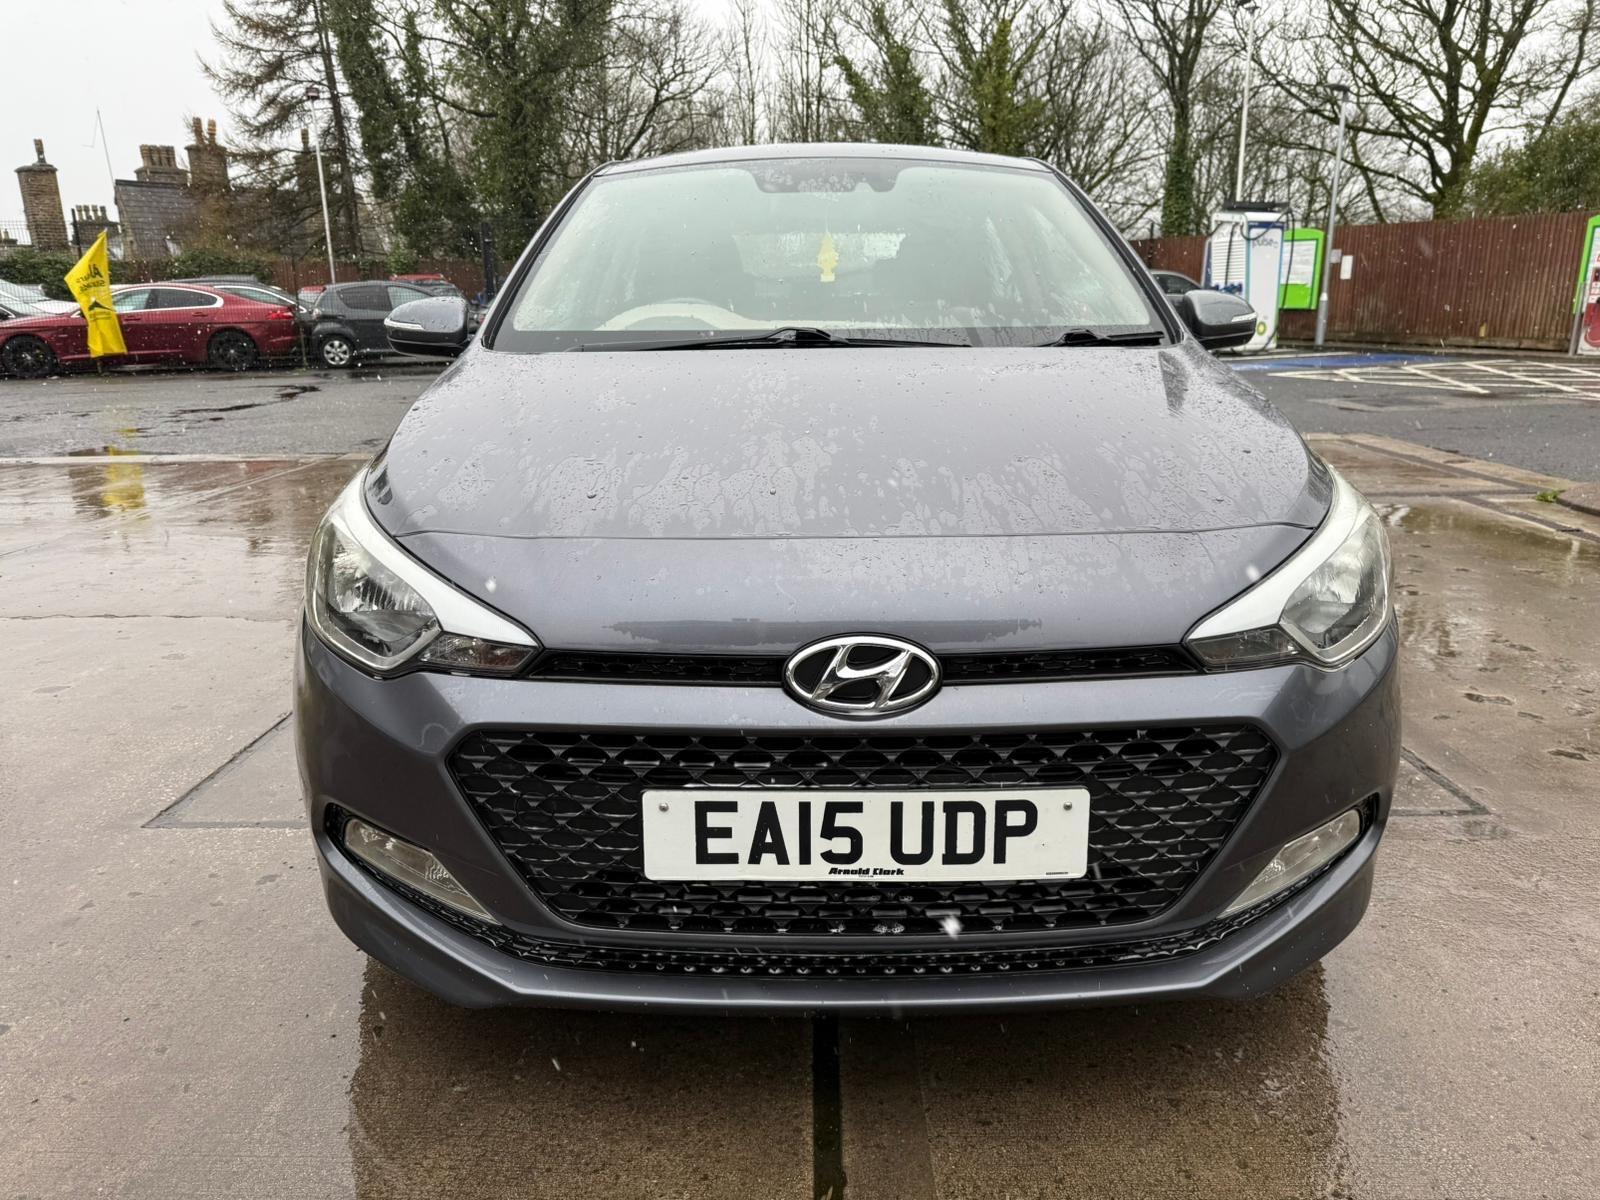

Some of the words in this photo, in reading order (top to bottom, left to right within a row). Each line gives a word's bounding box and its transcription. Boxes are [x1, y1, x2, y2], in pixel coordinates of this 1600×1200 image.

[695, 800, 863, 865] EA15
[890, 799, 1038, 865] UDP
[828, 867, 870, 875] Arnold
[873, 868, 905, 876] Clark
